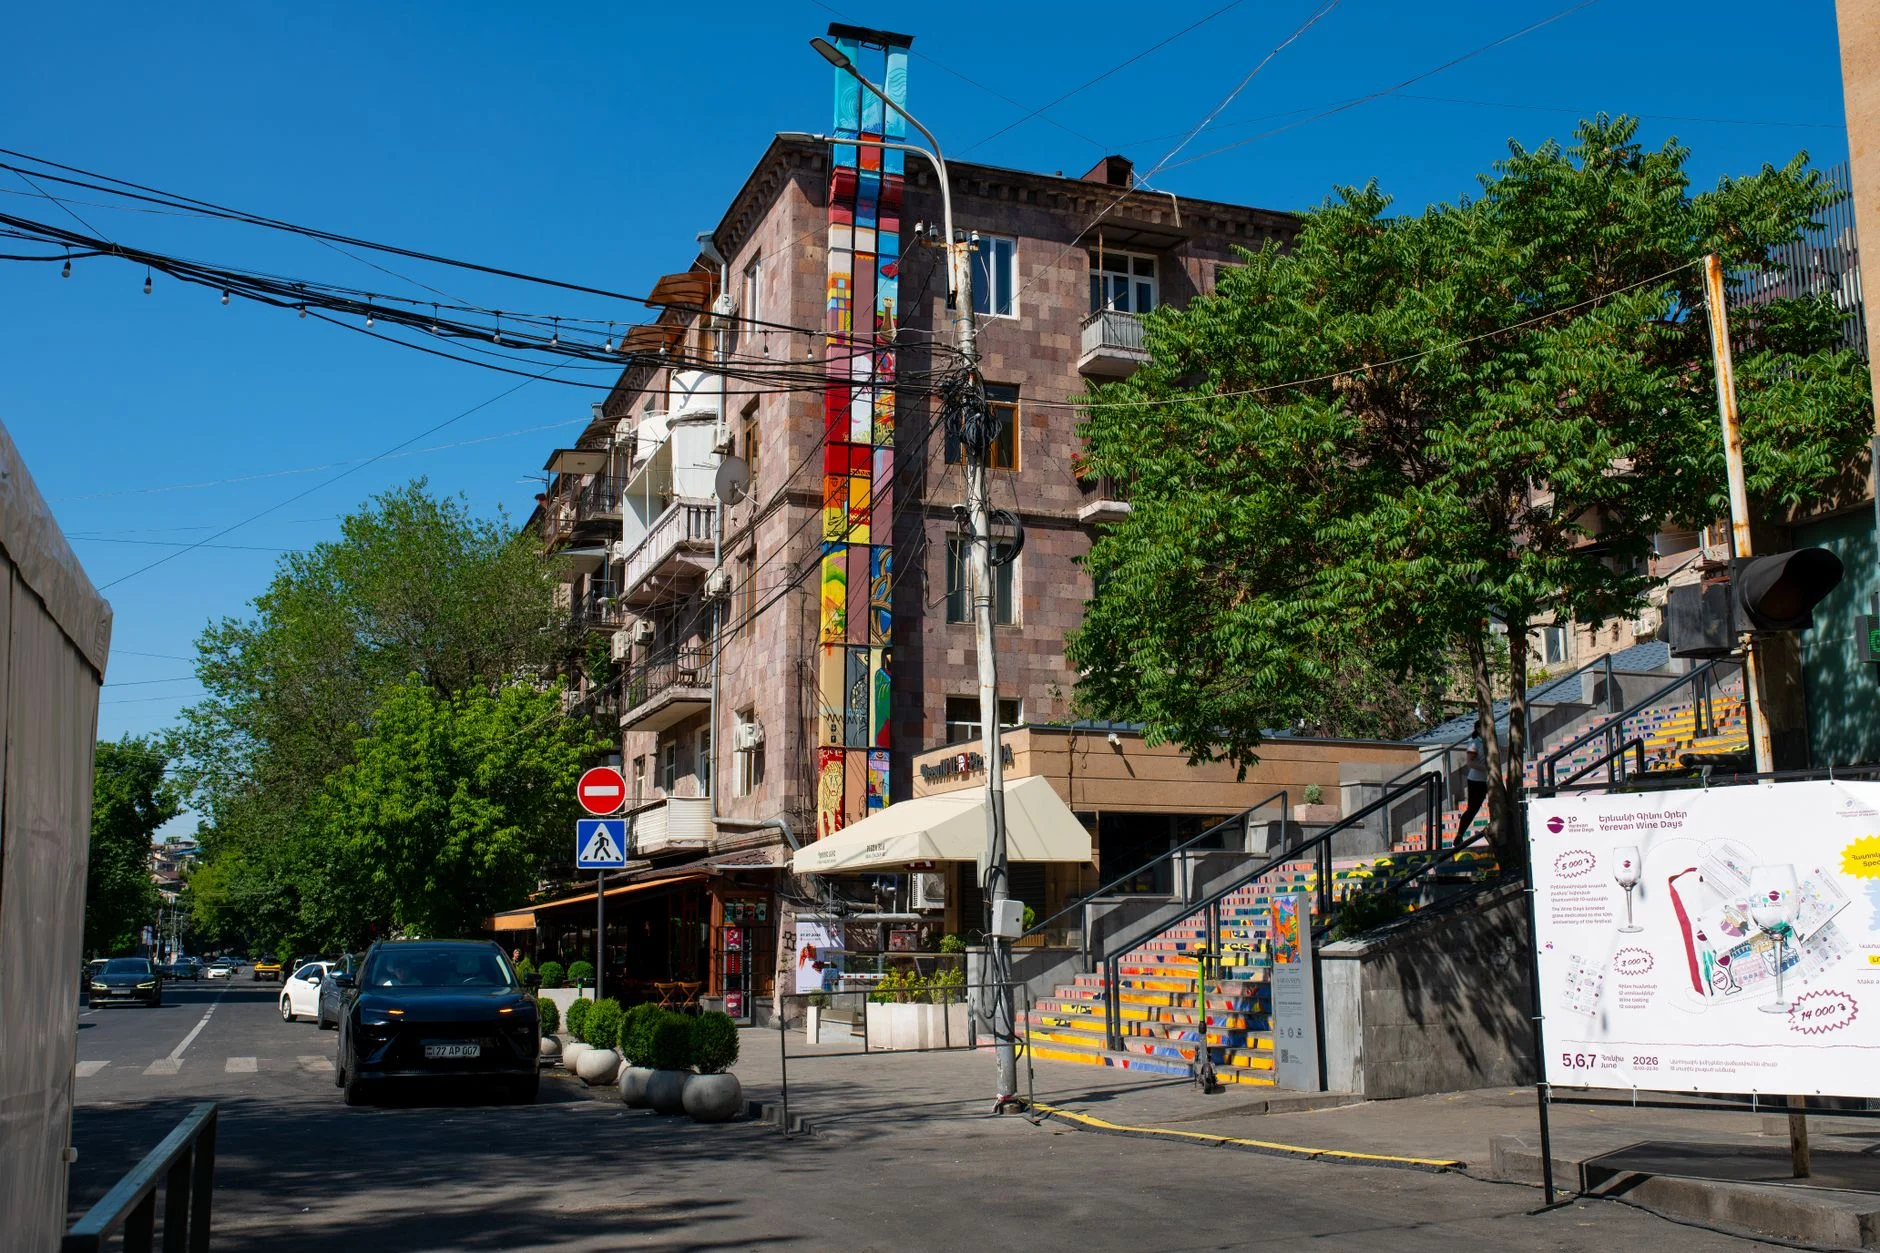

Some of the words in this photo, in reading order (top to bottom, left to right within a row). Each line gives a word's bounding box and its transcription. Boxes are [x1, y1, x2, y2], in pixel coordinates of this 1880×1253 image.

[1664, 811, 1688, 820] Օրեր
[1599, 823, 1634, 831] Yerevan
[1636, 822, 1658, 830] Wine
[1660, 820, 1683, 829] Days
[1568, 859, 1583, 868] 000
[1801, 1010, 1812, 1021] 14
[1815, 1005, 1835, 1017] 000
[1562, 1053, 1596, 1070] 5,6,7
[1632, 1056, 1659, 1066] 2026
